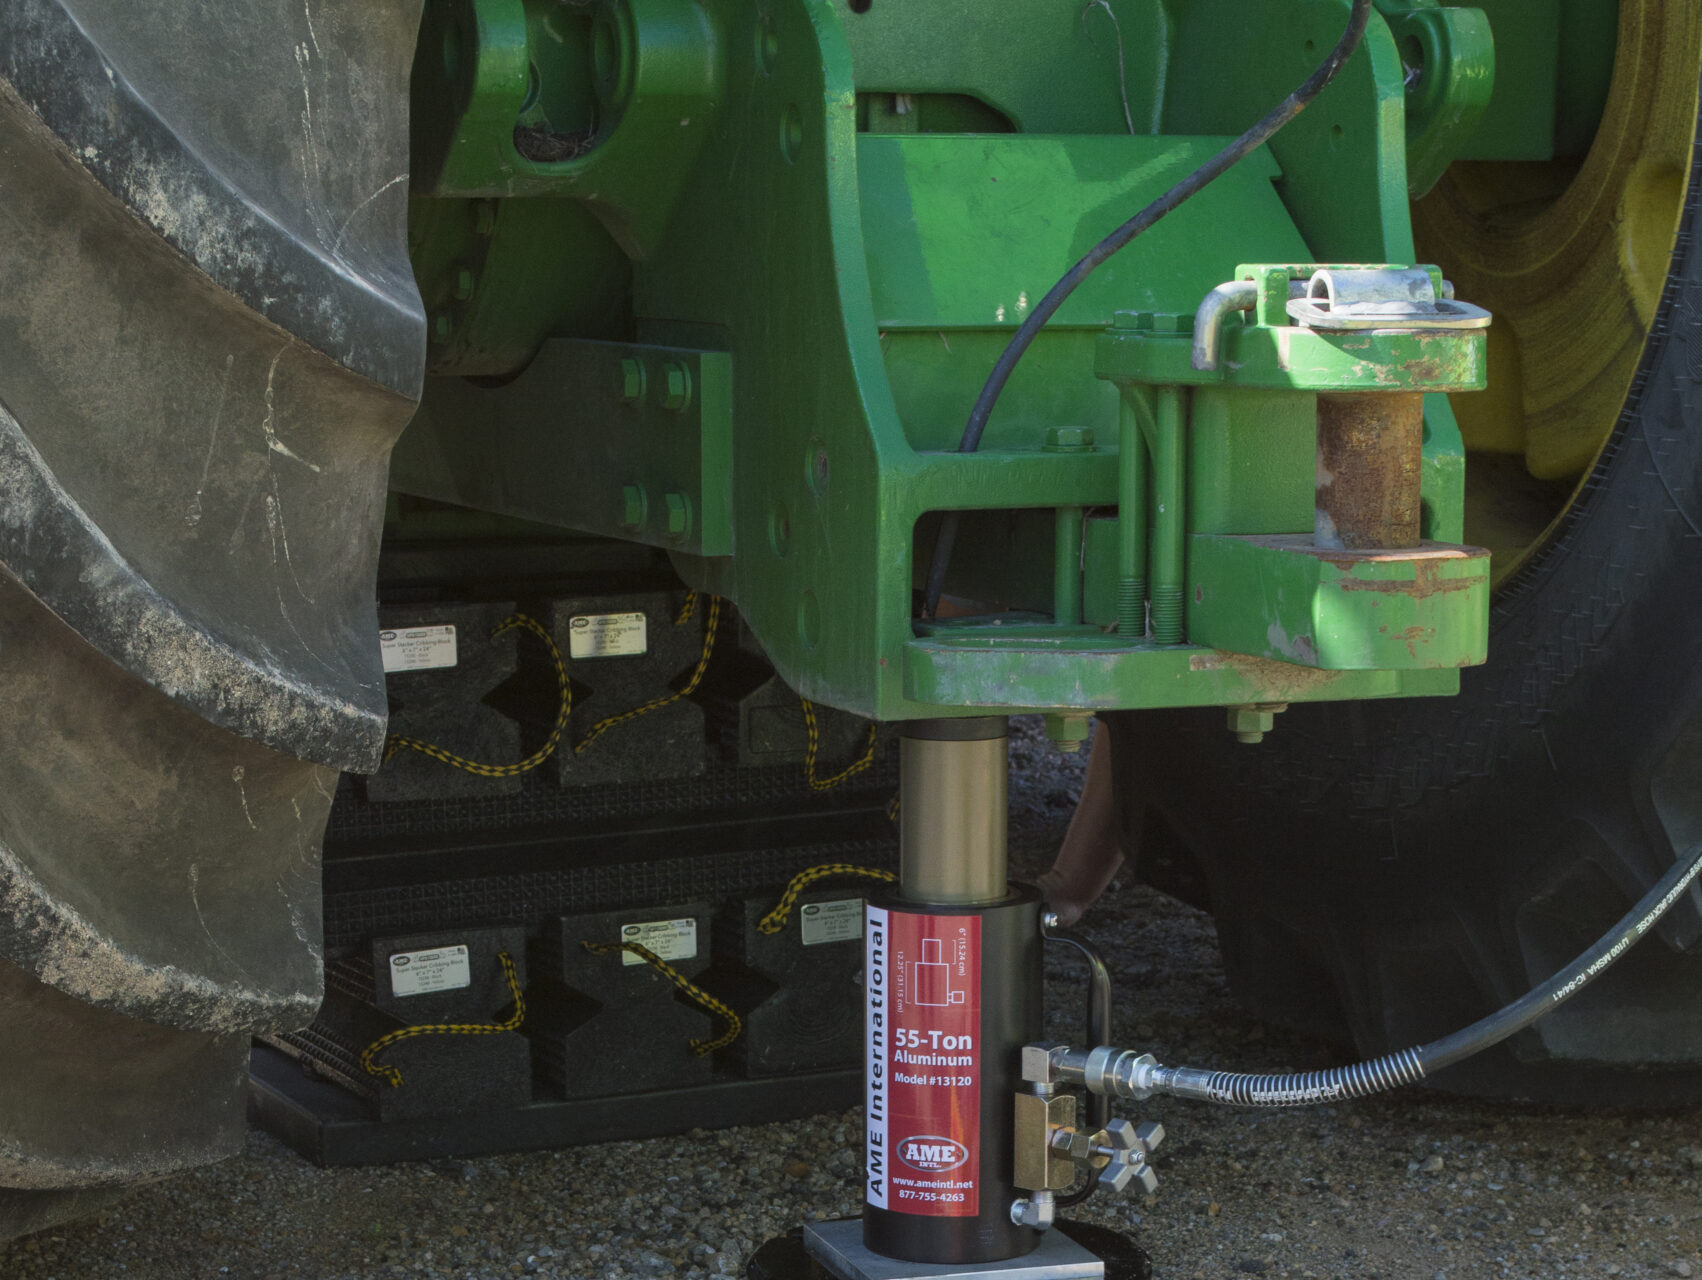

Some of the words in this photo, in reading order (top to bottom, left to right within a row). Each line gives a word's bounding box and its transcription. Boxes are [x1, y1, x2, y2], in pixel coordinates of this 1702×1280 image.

[1653, 897, 1667, 917] JACK
[1636, 912, 1655, 933] HOSE
[1587, 953, 1611, 976] MSHA
[870, 919, 883, 1122] International
[895, 1028, 972, 1050] 55-Ton
[895, 1050, 972, 1066] Aluminum
[895, 1072, 926, 1085] Model
[929, 1076, 972, 1086] #13120
[906, 1144, 955, 1162] AME
[870, 1131, 883, 1197] AME
[892, 1177, 973, 1189] www.ameintl.net
[899, 1190, 965, 1202] 877-755-4263
